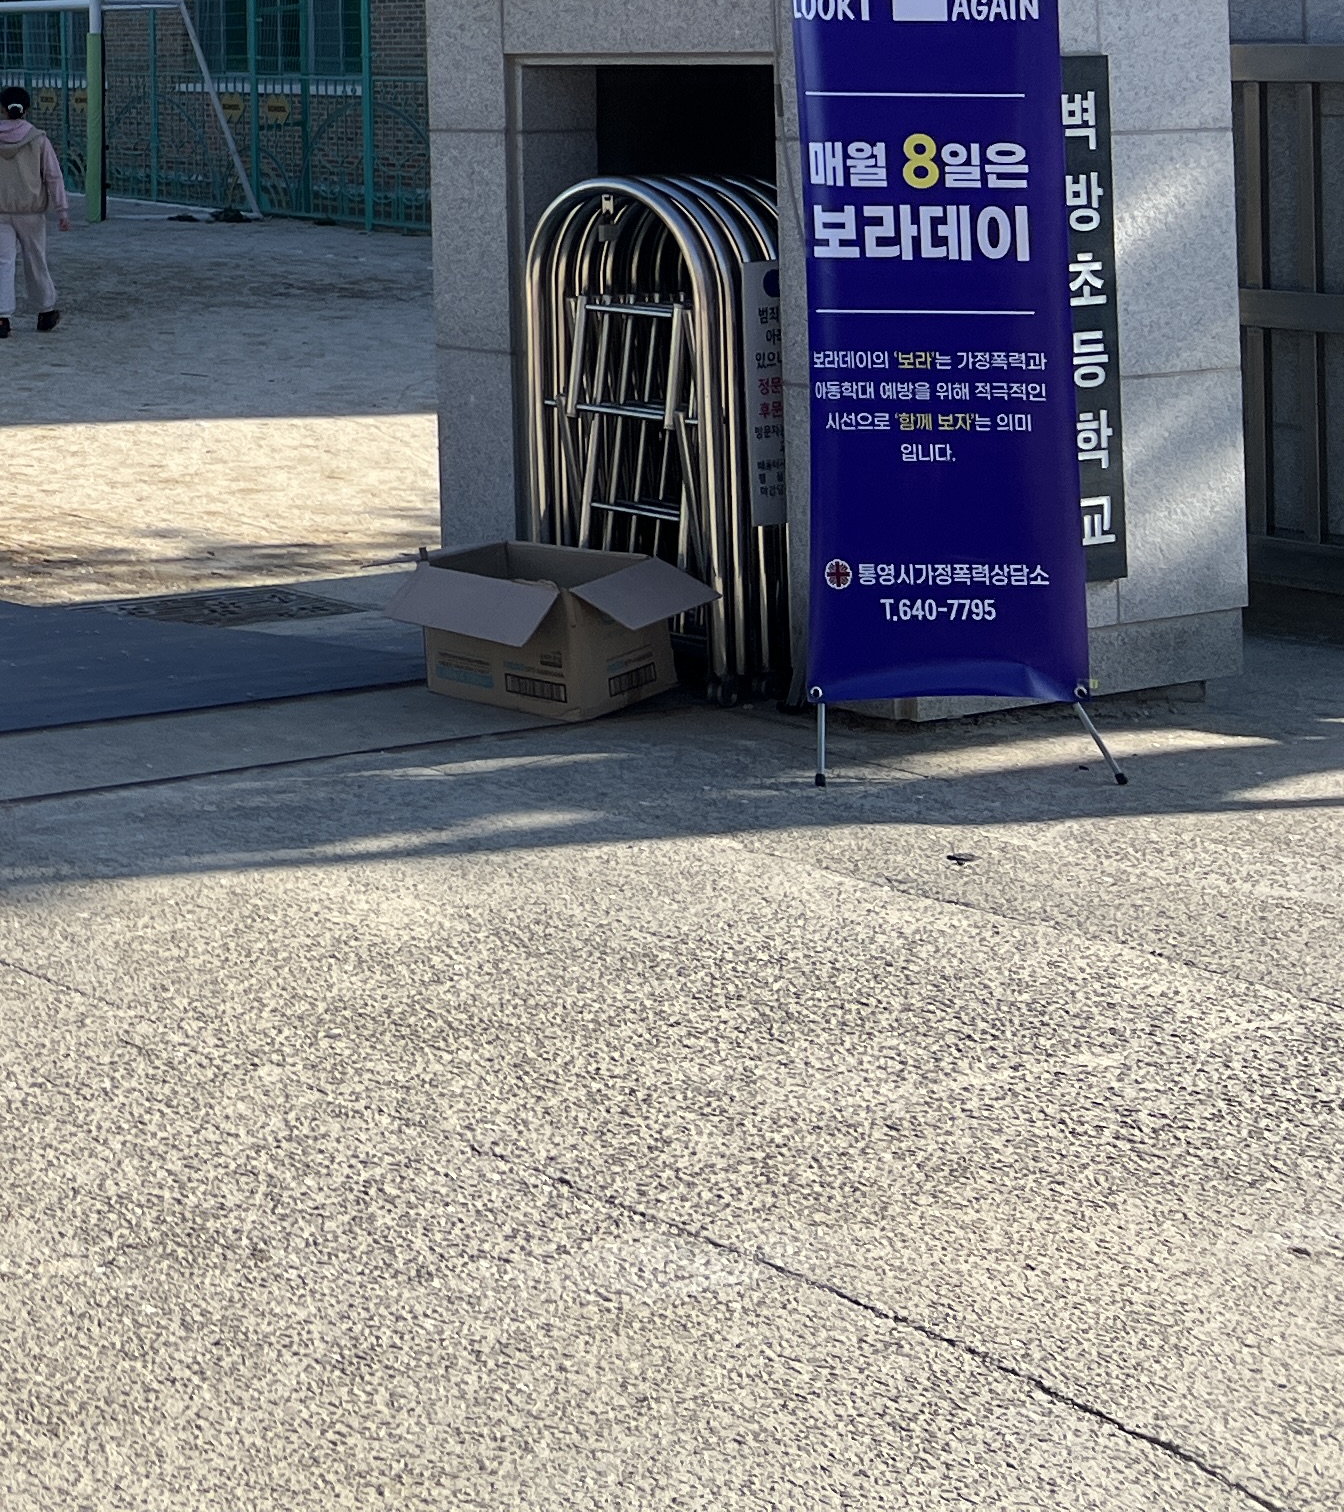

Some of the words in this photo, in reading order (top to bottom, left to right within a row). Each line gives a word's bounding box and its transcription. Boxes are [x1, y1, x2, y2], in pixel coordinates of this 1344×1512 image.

[808, 141, 888, 188] 매월
[902, 133, 1030, 189] 8일은
[813, 204, 1031, 262] 보라데이
[1061, 90, 1116, 547] 벽방초등학교
[813, 350, 889, 370] 보라데이의
[957, 351, 1048, 372] 가정폭력과
[815, 381, 875, 401] 아동학대
[879, 382, 931, 401] 예방을
[936, 382, 970, 401] 위해
[974, 382, 1047, 402] 적극적인
[825, 412, 891, 431] 시선으로
[996, 413, 1032, 432] 의미
[900, 443, 956, 462] 입니다.
[858, 563, 1050, 587] 통영시가정폭력상담소
[880, 598, 996, 622] T.640-7795
